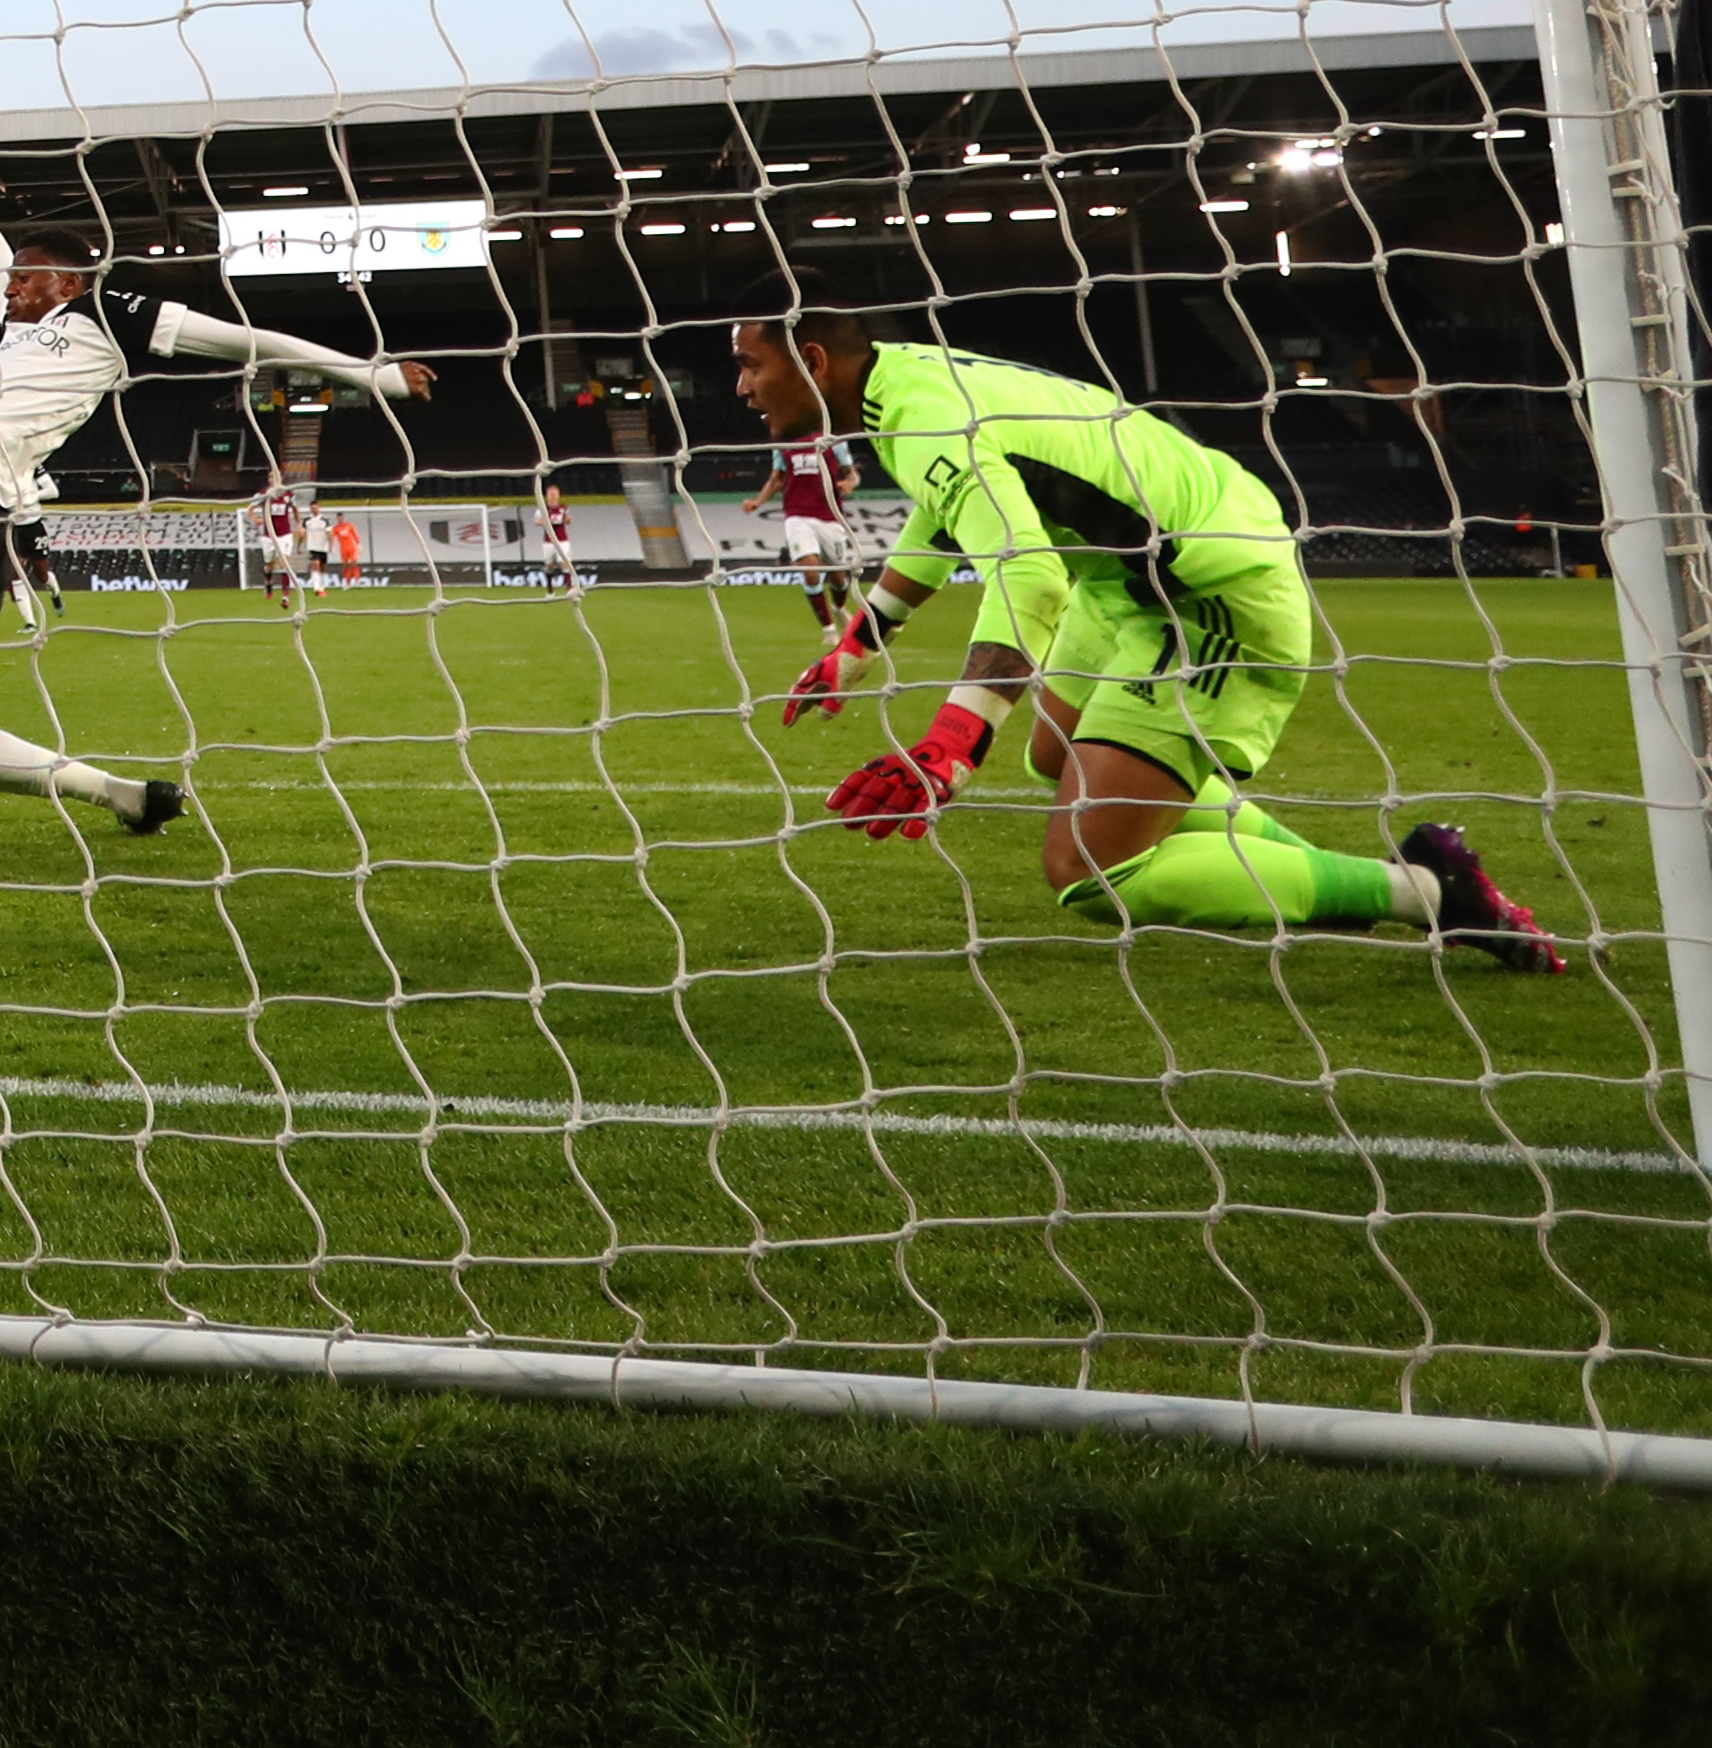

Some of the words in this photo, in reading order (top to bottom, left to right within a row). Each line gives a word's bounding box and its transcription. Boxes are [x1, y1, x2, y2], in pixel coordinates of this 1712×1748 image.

[320, 231, 336, 254] 0
[368, 228, 385, 252] 0
[91, 574, 189, 591] betway
